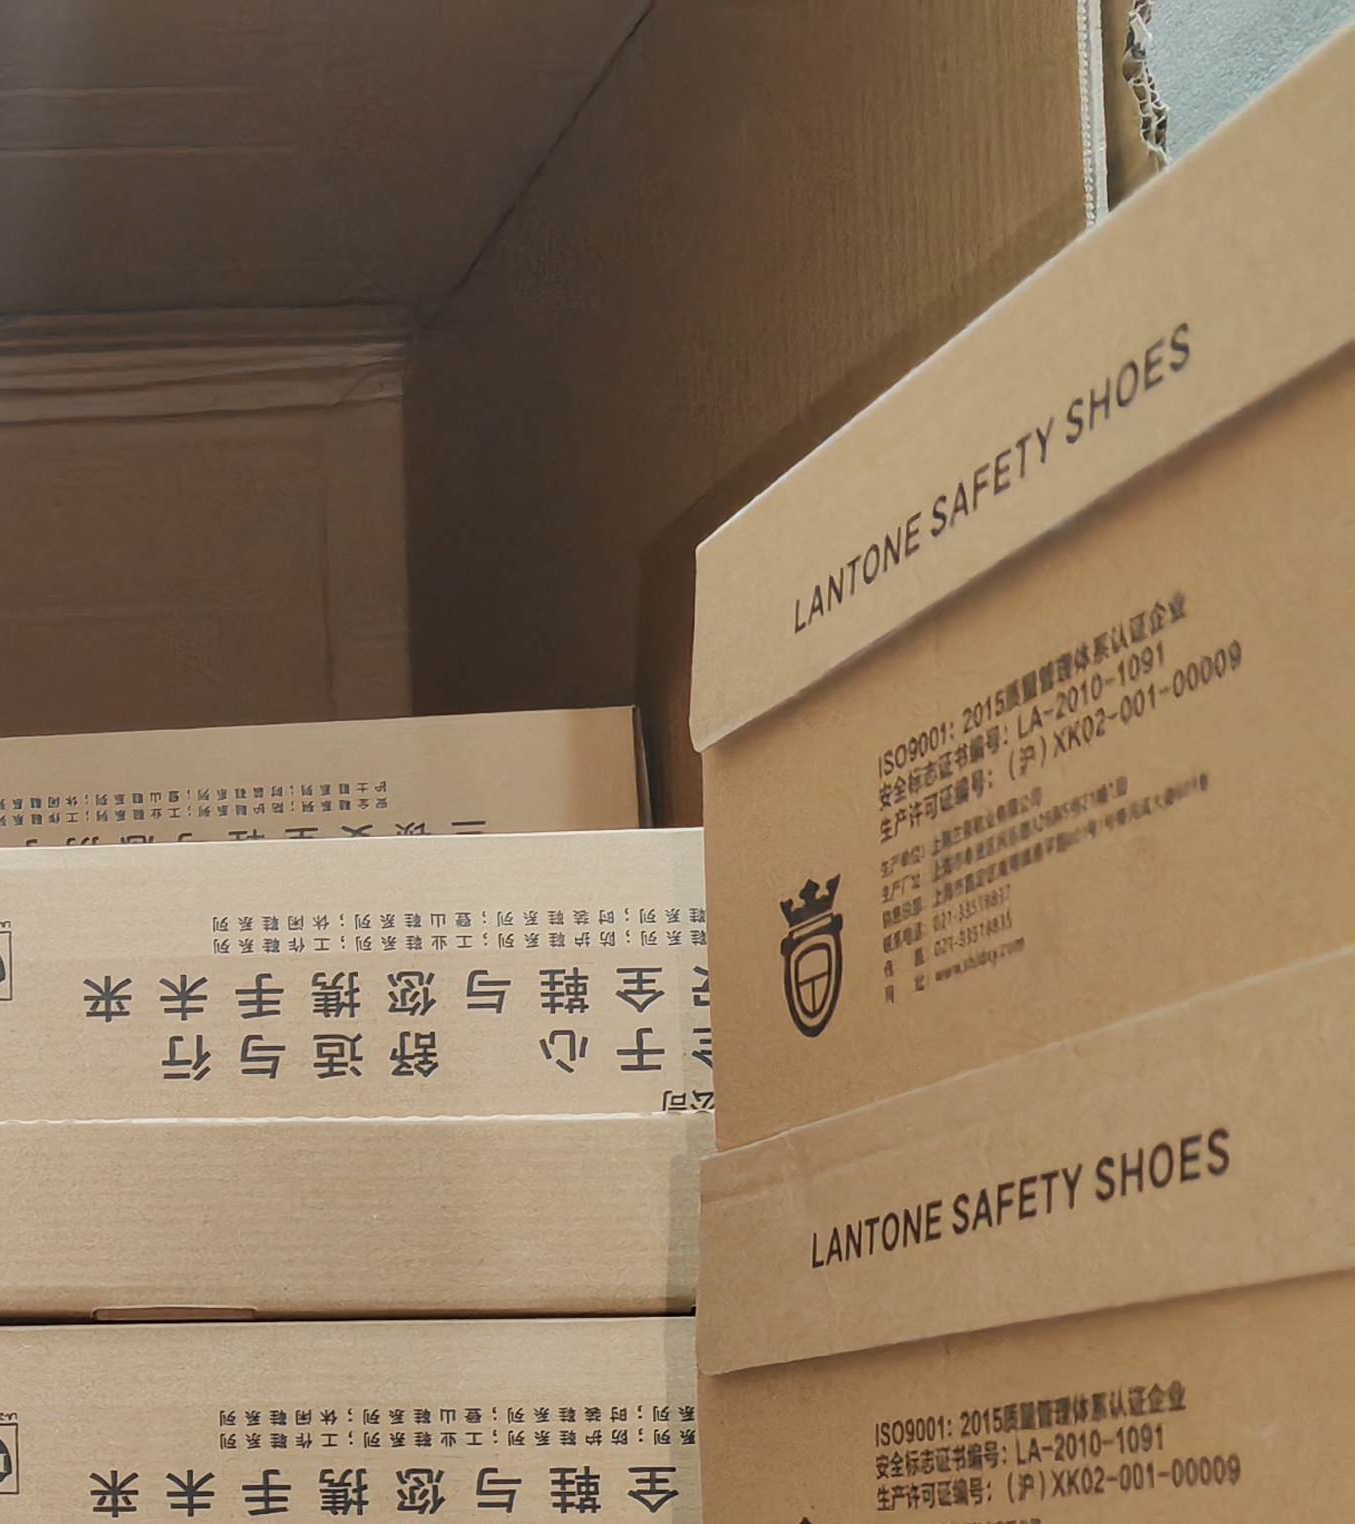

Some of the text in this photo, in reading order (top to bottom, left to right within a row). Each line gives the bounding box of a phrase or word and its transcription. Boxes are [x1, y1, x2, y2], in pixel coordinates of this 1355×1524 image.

[792, 321, 1193, 636] LANTONE SAFETY SHOES
[161, 1031, 440, 1081] 舒适与行
[811, 1128, 1231, 1268] LANTONE SAFETY SHOES
[90, 1466, 680, 1519] 全鞋与您携手未来
